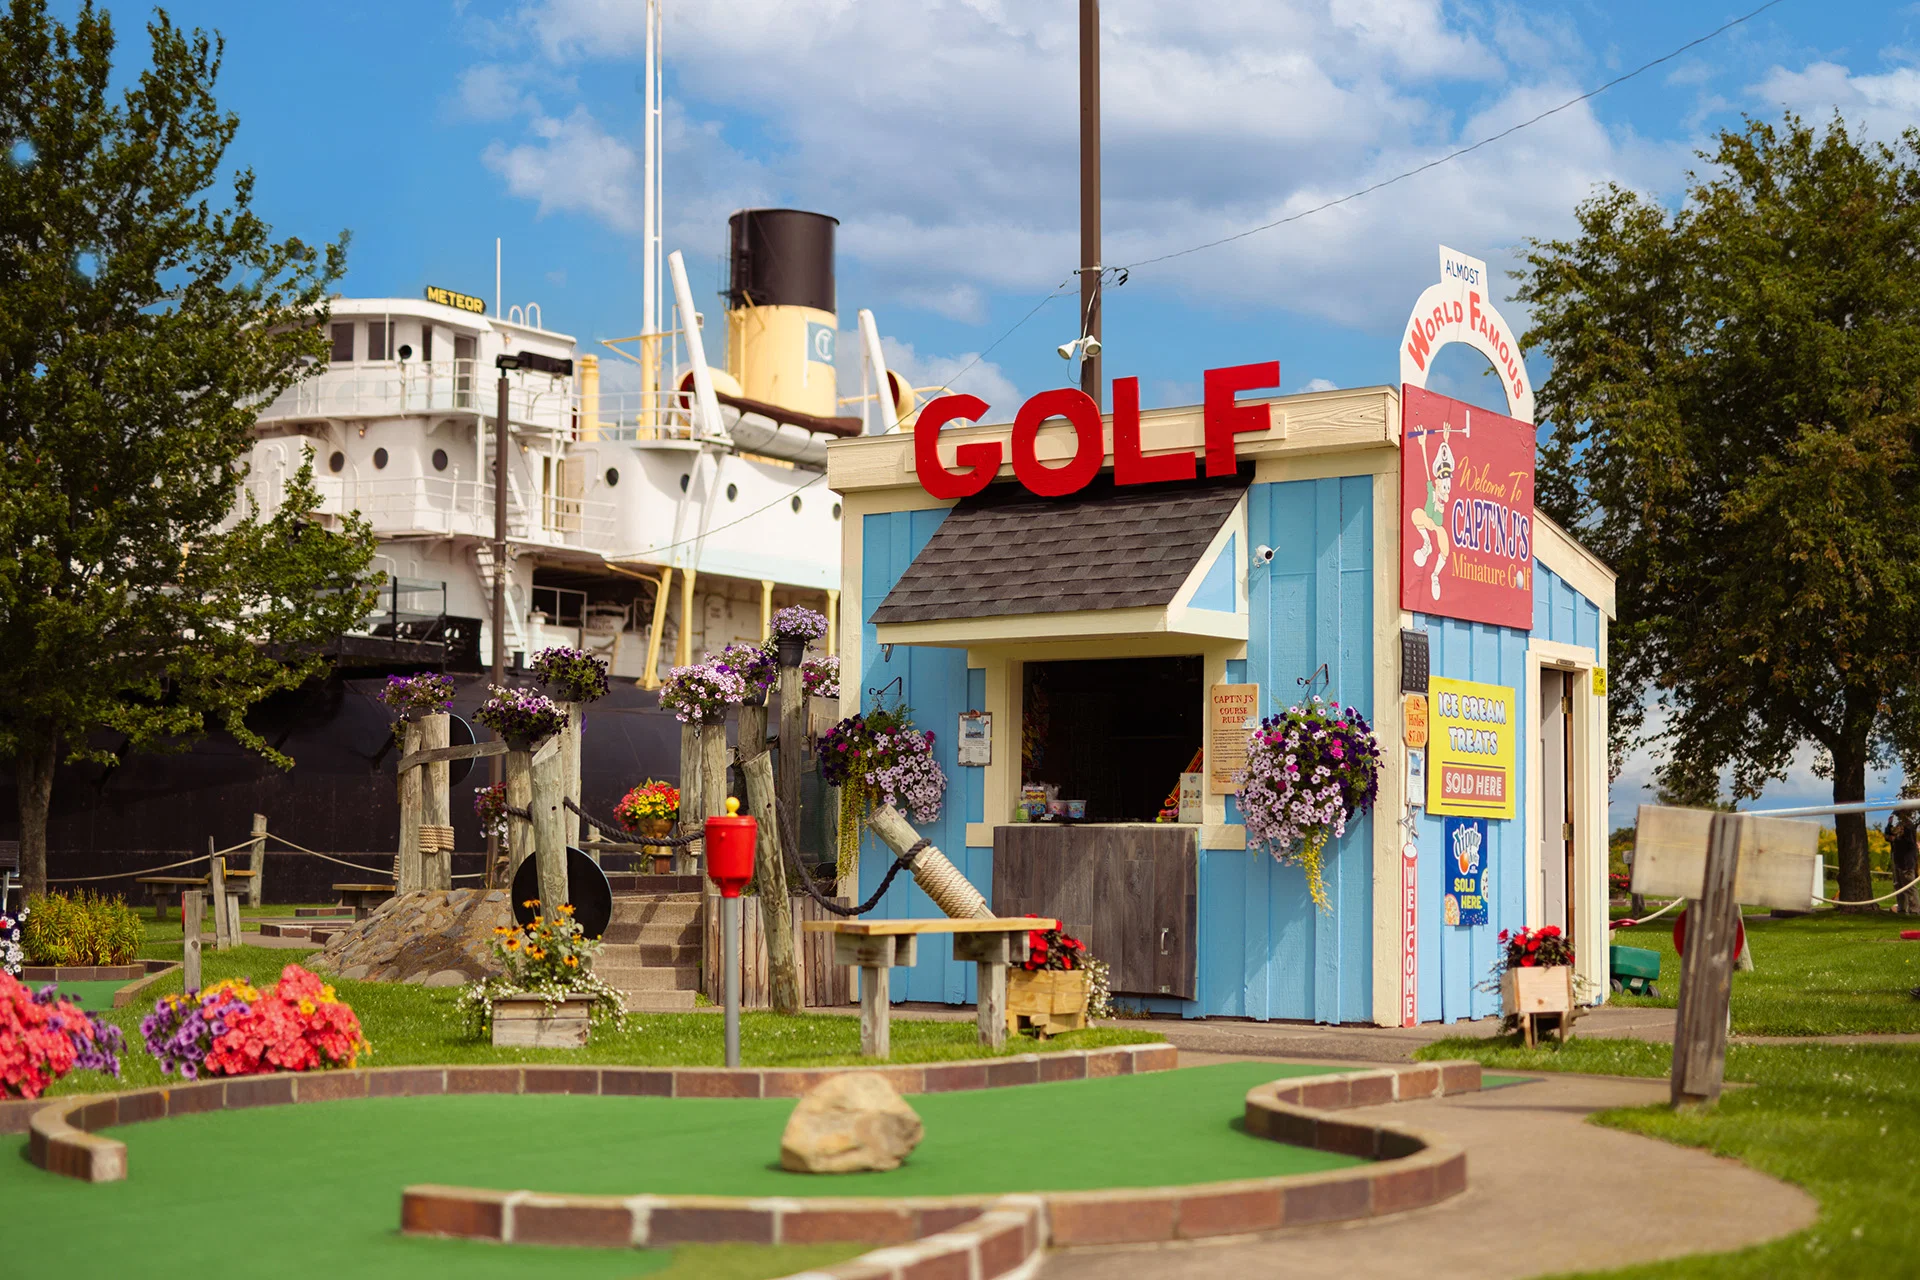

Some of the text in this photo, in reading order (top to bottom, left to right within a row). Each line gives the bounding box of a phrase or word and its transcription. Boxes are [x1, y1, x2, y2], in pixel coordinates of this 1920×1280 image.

[1446, 260, 1479, 285] ALMOST
[428, 286, 483, 313] METEOR
[1408, 291, 1523, 399] WORLD FAMOUS
[914, 361, 1280, 500] GOLF
[1458, 456, 1528, 503] Welcome To
[1452, 499, 1530, 561] CAPT'N J'S
[1452, 552, 1506, 586] Miniature
[1214, 695, 1242, 704] CAPT'N
[1220, 707, 1248, 715] COURSE
[1438, 692, 1506, 724] ICE CREAM
[1222, 716, 1245, 724] RULES
[1408, 713, 1425, 727] Holes
[1448, 726, 1498, 755] TREATS
[1445, 772, 1474, 795] SOLD
[1475, 775, 1502, 796] HERE
[1454, 877, 1476, 892] SOLD
[1406, 866, 1415, 1018] WELCOME
